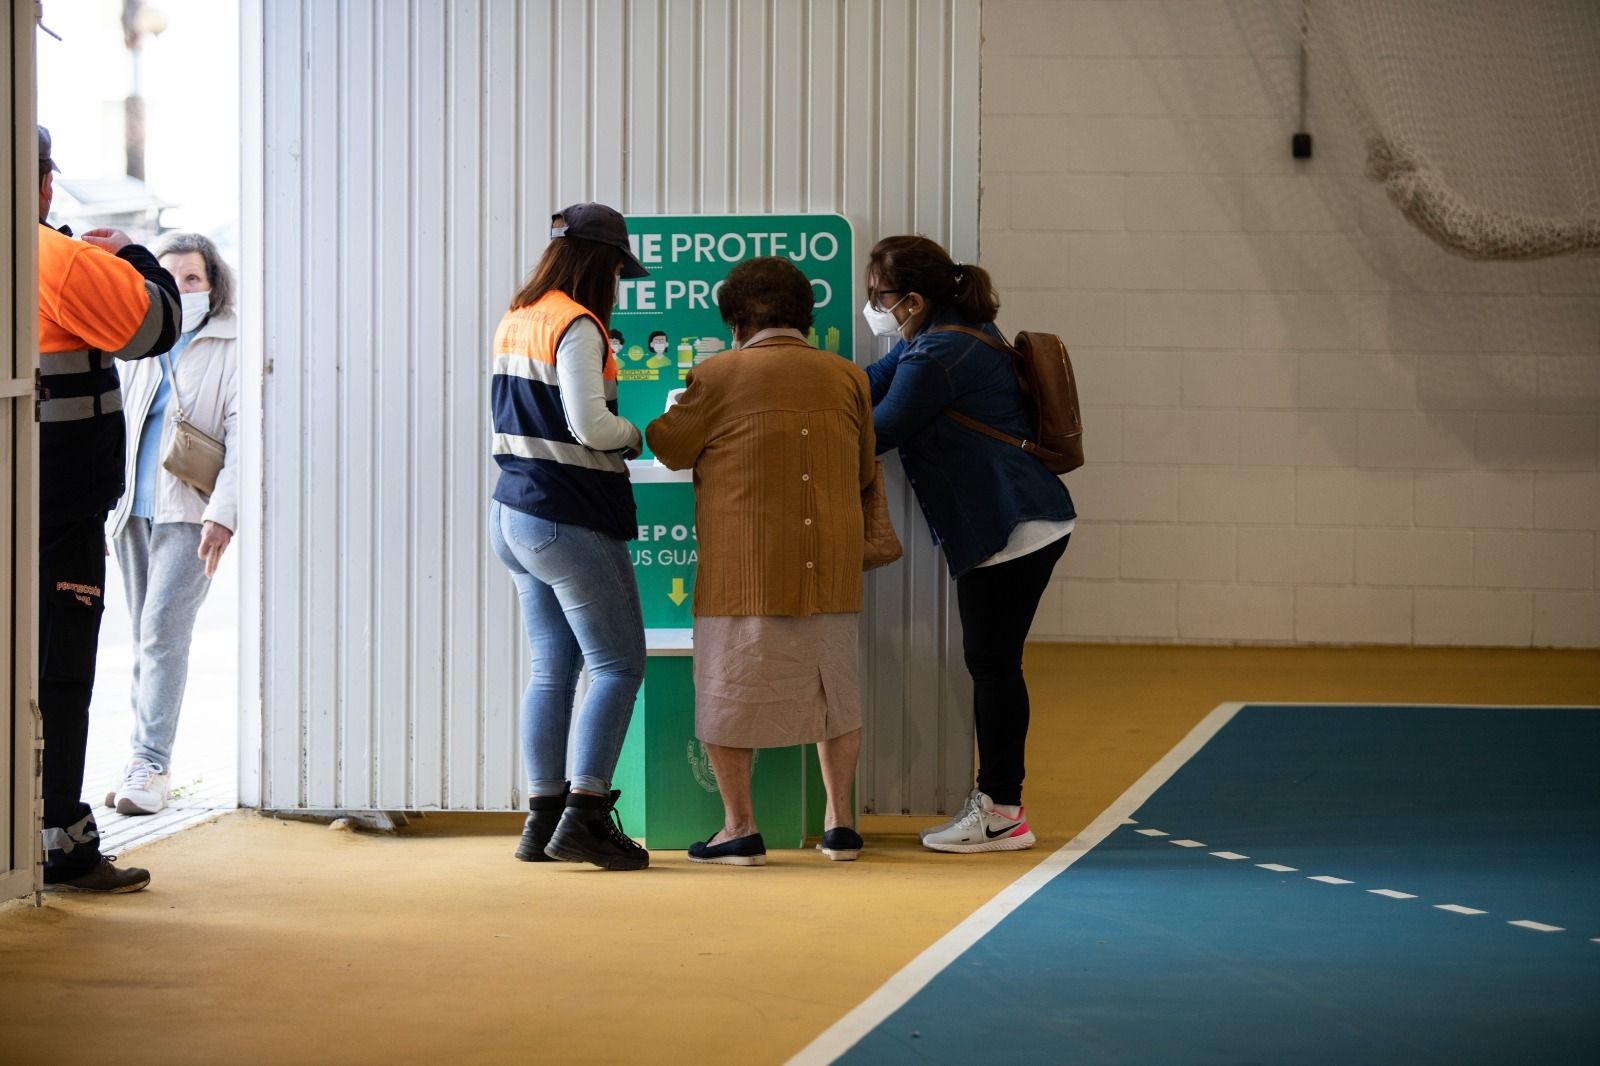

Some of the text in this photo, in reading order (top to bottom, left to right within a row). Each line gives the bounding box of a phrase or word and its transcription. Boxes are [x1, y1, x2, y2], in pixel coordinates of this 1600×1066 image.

[671, 231, 838, 262] PROTEJO
[619, 280, 656, 310] TE
[628, 549, 698, 566] US GUA
